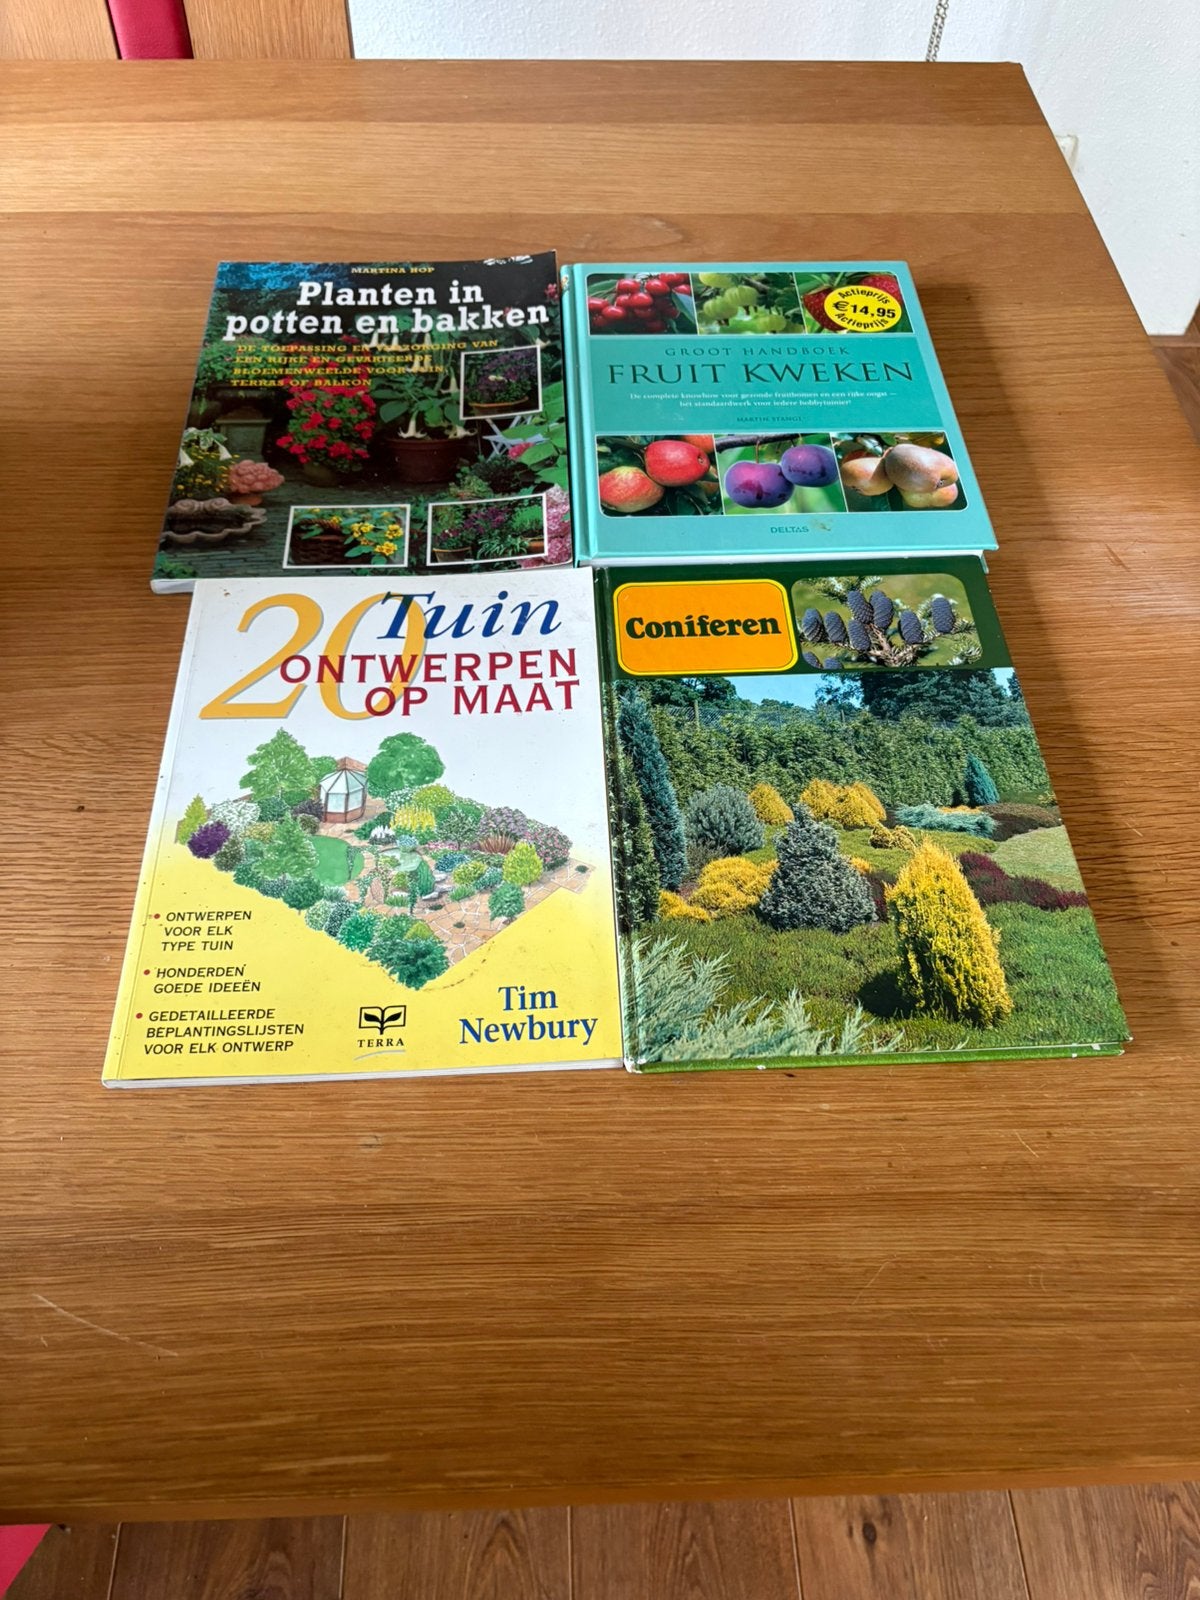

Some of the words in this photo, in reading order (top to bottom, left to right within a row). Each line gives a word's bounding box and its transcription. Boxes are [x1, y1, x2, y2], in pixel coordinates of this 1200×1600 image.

[296, 281, 436, 306] Planten
[448, 280, 484, 304] in
[838, 288, 890, 304] Actieprijs
[222, 310, 343, 341] potten
[356, 315, 398, 334] en
[411, 305, 550, 334] bakken
[834, 312, 889, 330] Actieprijs
[262, 344, 346, 352] TOEPASSING
[352, 344, 370, 352] EN
[472, 340, 498, 348] VAN
[665, 346, 732, 356] GROOT
[743, 346, 850, 356] HANDBOEK
[268, 356, 308, 364] RIJKE
[367, 366, 406, 374] VOOR
[608, 363, 726, 384] FRUIT
[743, 362, 914, 383] KWEKEN
[770, 526, 810, 534] DELTAS
[376, 590, 562, 640] Tuin
[625, 614, 782, 640] Coniferen
[198, 592, 428, 721] 20
[279, 648, 578, 685] ONTWERPEN
[365, 686, 428, 717] OP
[453, 678, 580, 716] MAAT
[166, 910, 252, 922] ONTWERPEN
[164, 926, 202, 937] VOOR
[207, 925, 233, 936] ELK
[161, 940, 196, 952] TYPE
[201, 940, 234, 951] TUIN
[156, 966, 244, 978] HONDERDEN
[154, 982, 203, 994] GOEDE
[208, 978, 261, 993] IDEEËN
[498, 985, 558, 1011] Tim
[149, 1008, 276, 1022] GEDETAILLEERDE
[146, 1024, 305, 1038] BEPLANTINGSLIJSTEN
[458, 1014, 598, 1046] Newbury
[144, 1043, 183, 1055] VOOR
[189, 1042, 217, 1054] ELK
[222, 1040, 294, 1053] ONTWERP
[357, 1038, 405, 1048] TERRA
